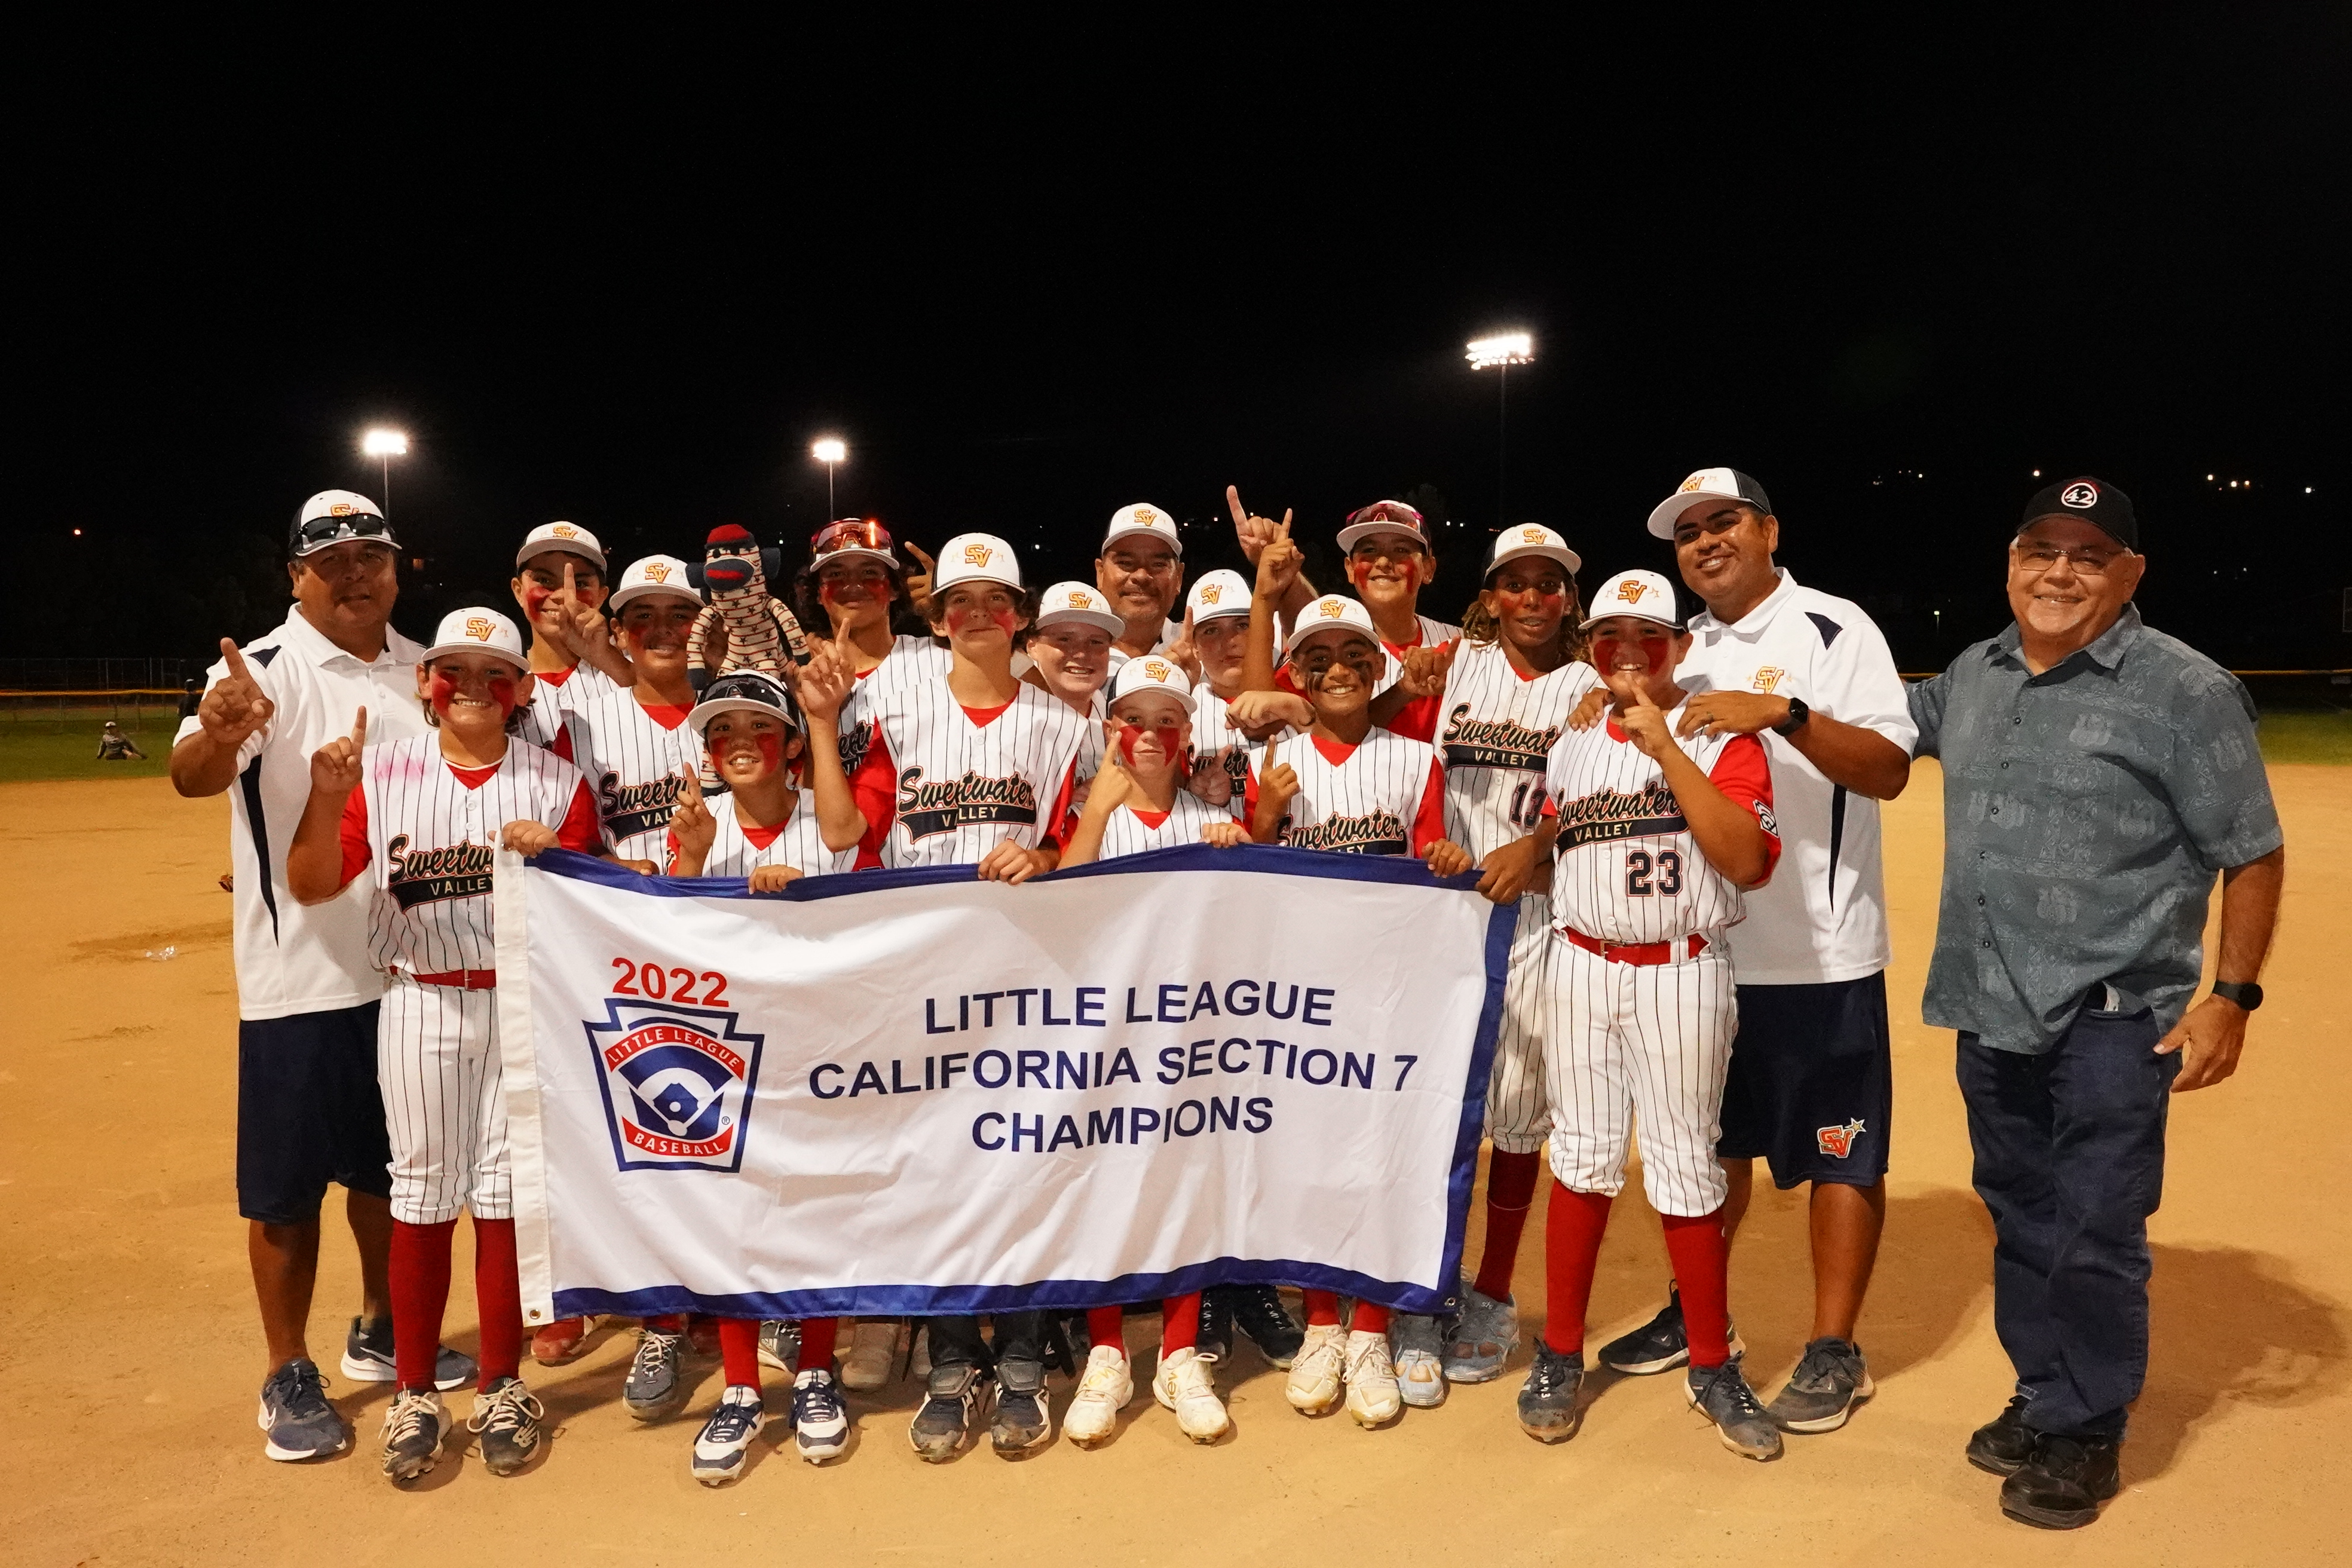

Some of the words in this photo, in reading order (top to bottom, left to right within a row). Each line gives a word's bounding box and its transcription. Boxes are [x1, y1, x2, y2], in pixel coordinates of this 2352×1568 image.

[2065, 488, 2093, 505] 42
[330, 504, 360, 517] S
[1134, 509, 1157, 526] SV
[553, 525, 578, 538] SV
[1523, 528, 1547, 544] SV
[965, 544, 993, 567] SV
[645, 563, 672, 583] SV
[1068, 592, 1092, 608] SV
[1201, 584, 1223, 605] SV
[1617, 580, 1647, 604] SV
[1320, 599, 1346, 618] SV
[466, 617, 495, 641] SV
[1145, 662, 1171, 682] SV
[1753, 666, 1784, 694] SV
[1475, 749, 1529, 766] VALLEY
[1508, 782, 1546, 828] 13
[942, 807, 999, 827] VLLEY
[1575, 822, 1627, 842] VALLEY
[1625, 850, 1683, 897] 23
[430, 877, 494, 896] VALLE
[611, 957, 730, 1007] 2022
[926, 988, 1105, 1034] LITTLE
[1126, 980, 1334, 1025] LEAGUE
[608, 1028, 664, 1063] LITTLE
[674, 1030, 740, 1068] LEAGUE
[810, 1048, 1141, 1099] CALIFORNIA
[1157, 1038, 1375, 1089] SECTION
[1395, 1055, 1418, 1092] 7
[973, 1096, 1273, 1152] CHAMPIONS
[634, 1132, 724, 1154] BASEBALL
[1817, 1125, 1855, 1158] SV
